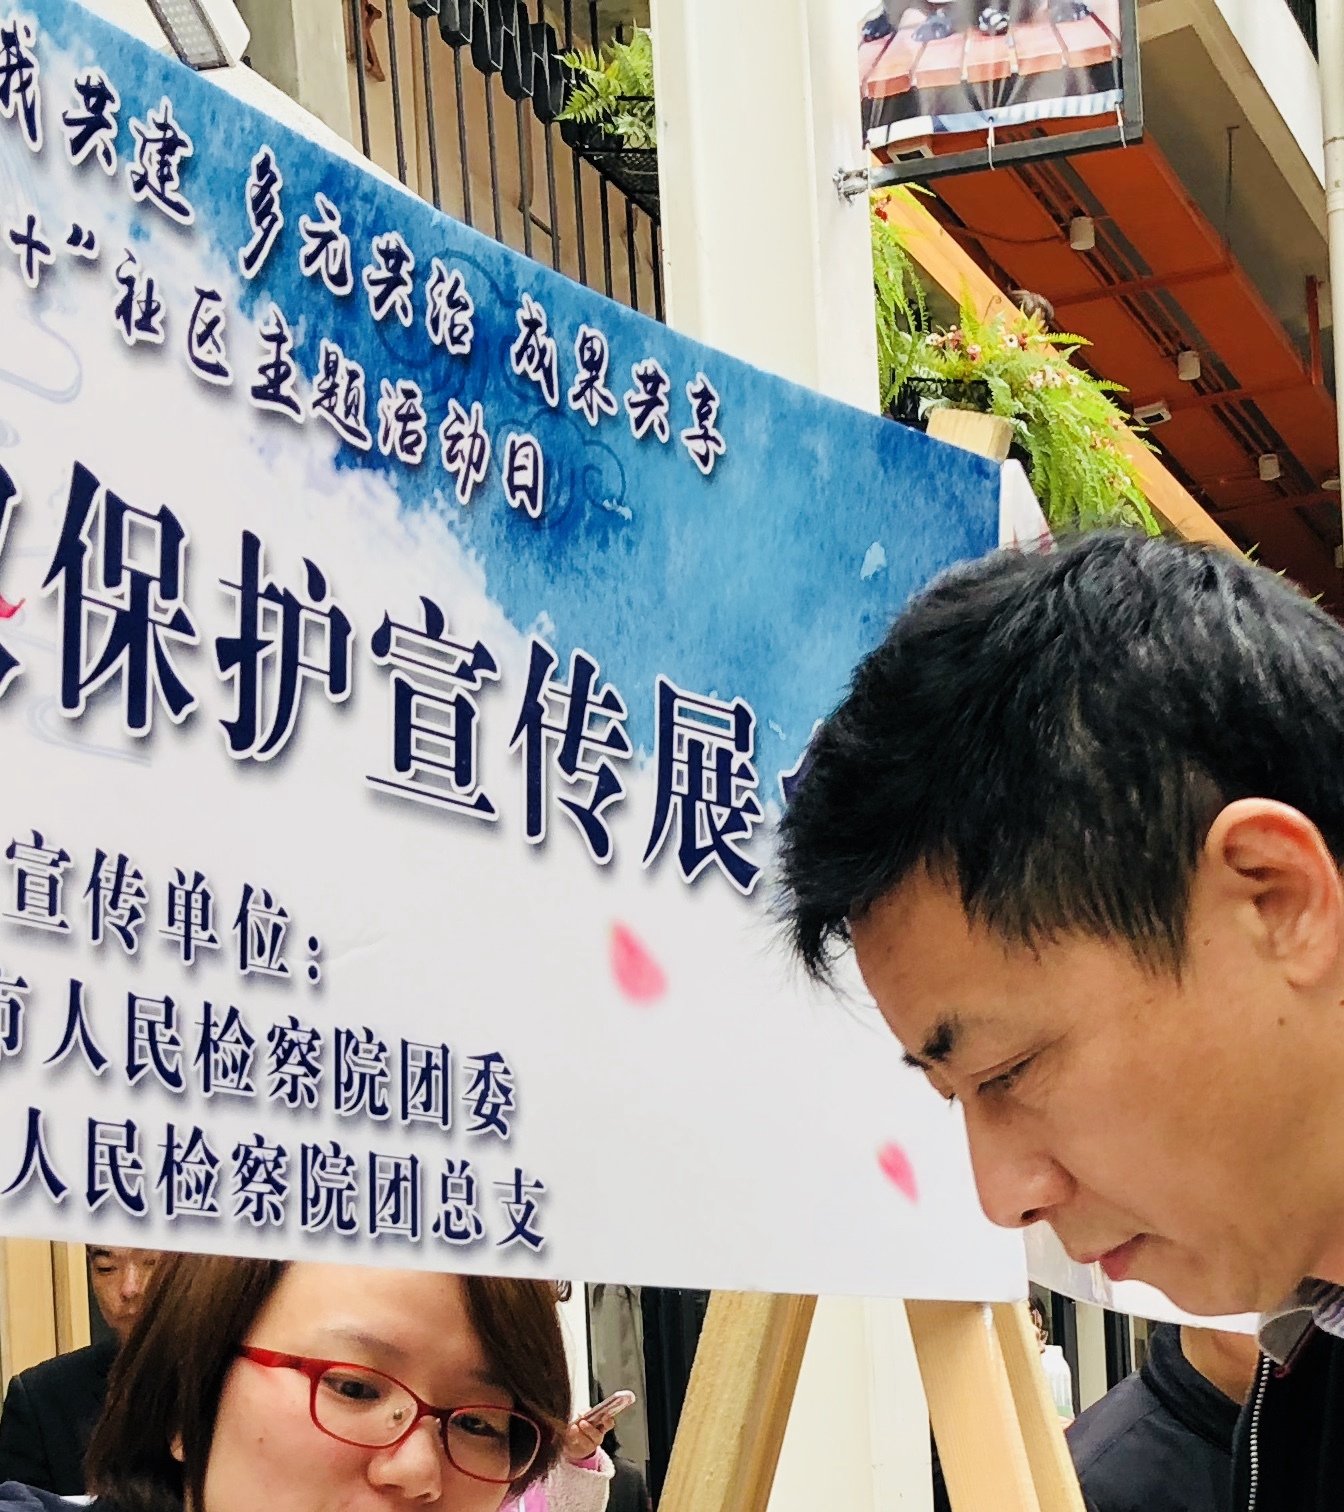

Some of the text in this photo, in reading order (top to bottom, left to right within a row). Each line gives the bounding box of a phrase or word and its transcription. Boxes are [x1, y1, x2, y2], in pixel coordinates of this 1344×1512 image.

[244, 152, 472, 352] 多元共治
[513, 296, 726, 472] 成果共享
